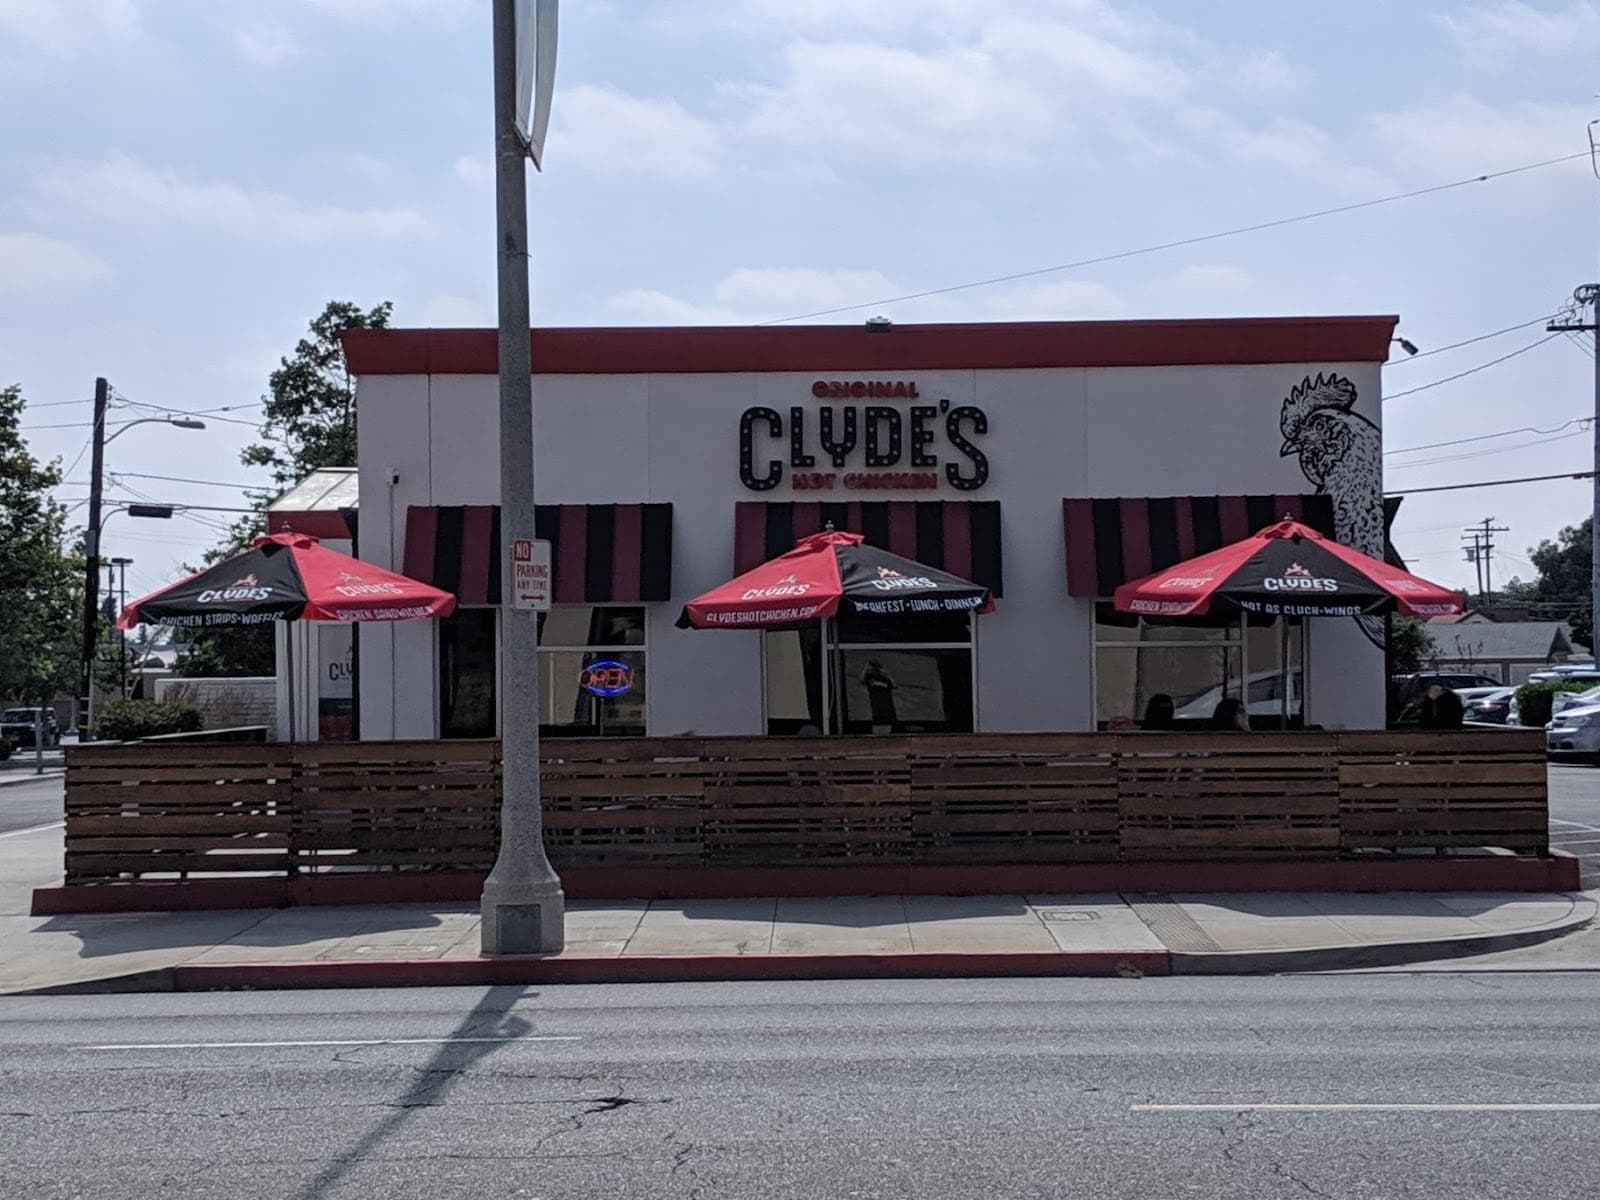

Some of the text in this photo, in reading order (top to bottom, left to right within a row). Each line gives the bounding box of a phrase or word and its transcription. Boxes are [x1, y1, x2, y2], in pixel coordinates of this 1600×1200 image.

[812, 381, 919, 398] ORIGINAL
[739, 399, 989, 491] CLYDE'S
[792, 473, 938, 490] HOT CHICKEN
[515, 542, 530, 559] NO
[516, 564, 548, 578] PARKING
[517, 581, 530, 590] ANY
[576, 669, 634, 689] OPEN
